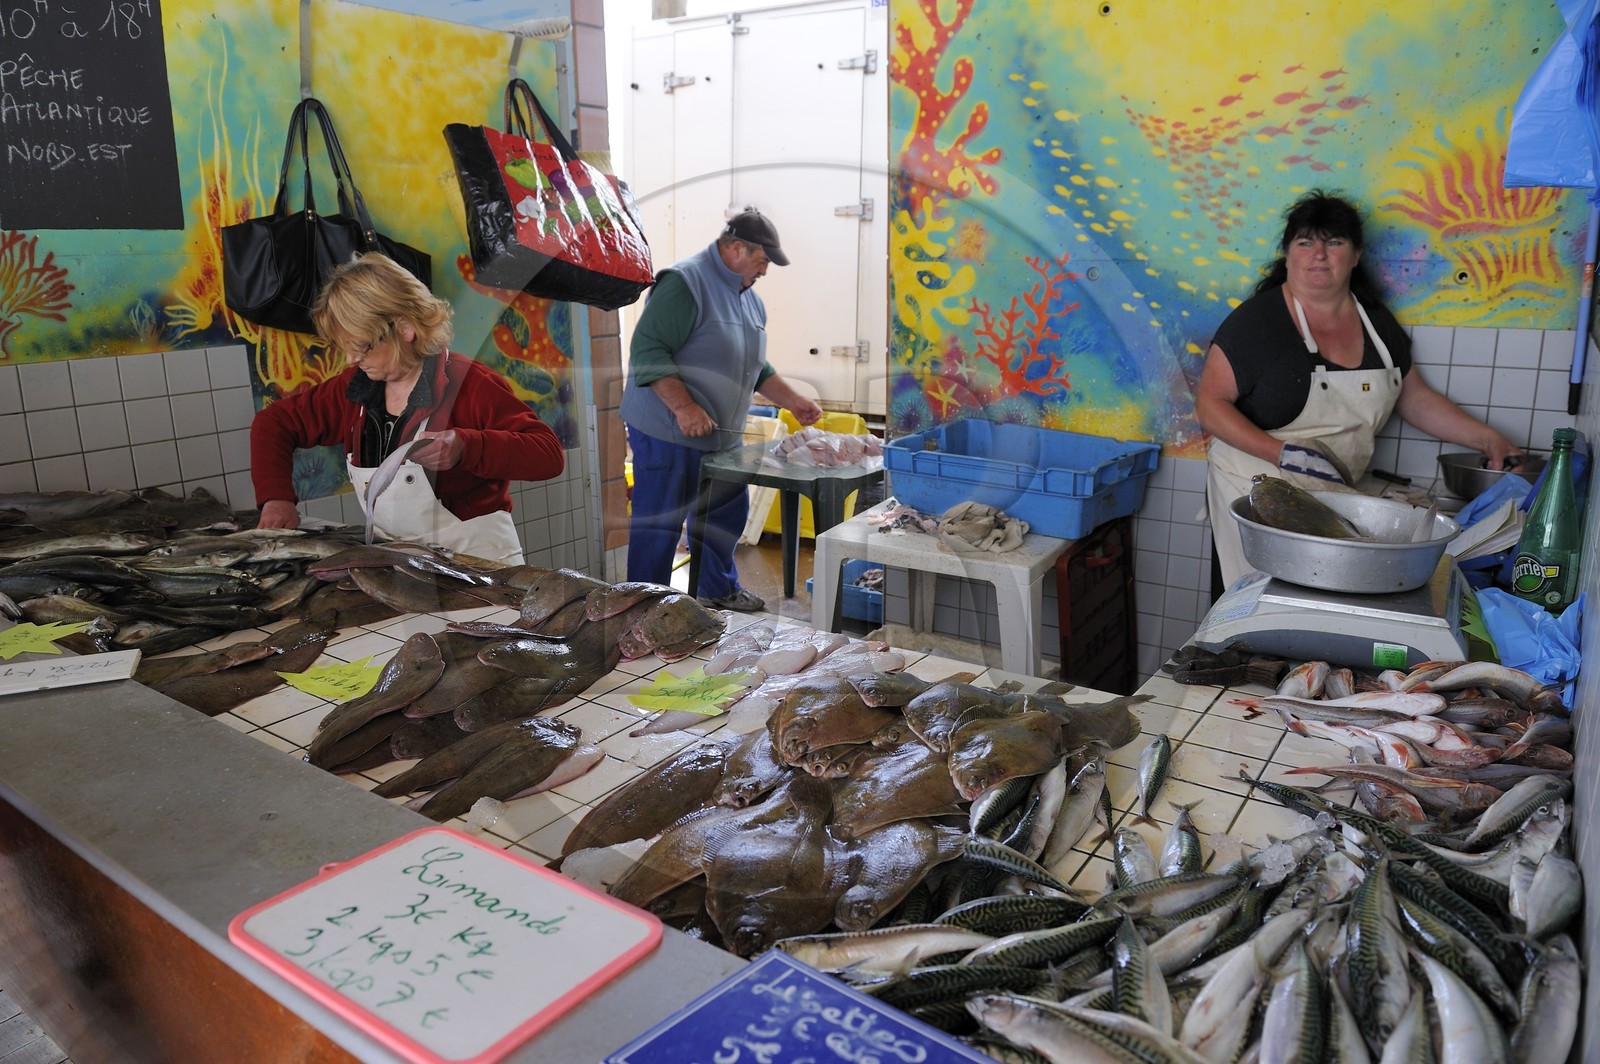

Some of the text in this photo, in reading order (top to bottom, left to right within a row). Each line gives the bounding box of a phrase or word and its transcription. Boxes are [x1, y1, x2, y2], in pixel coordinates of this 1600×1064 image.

[60, 5, 89, 38] à
[0, 53, 85, 91] PÊCHE
[402, 846, 567, 936] Limande
